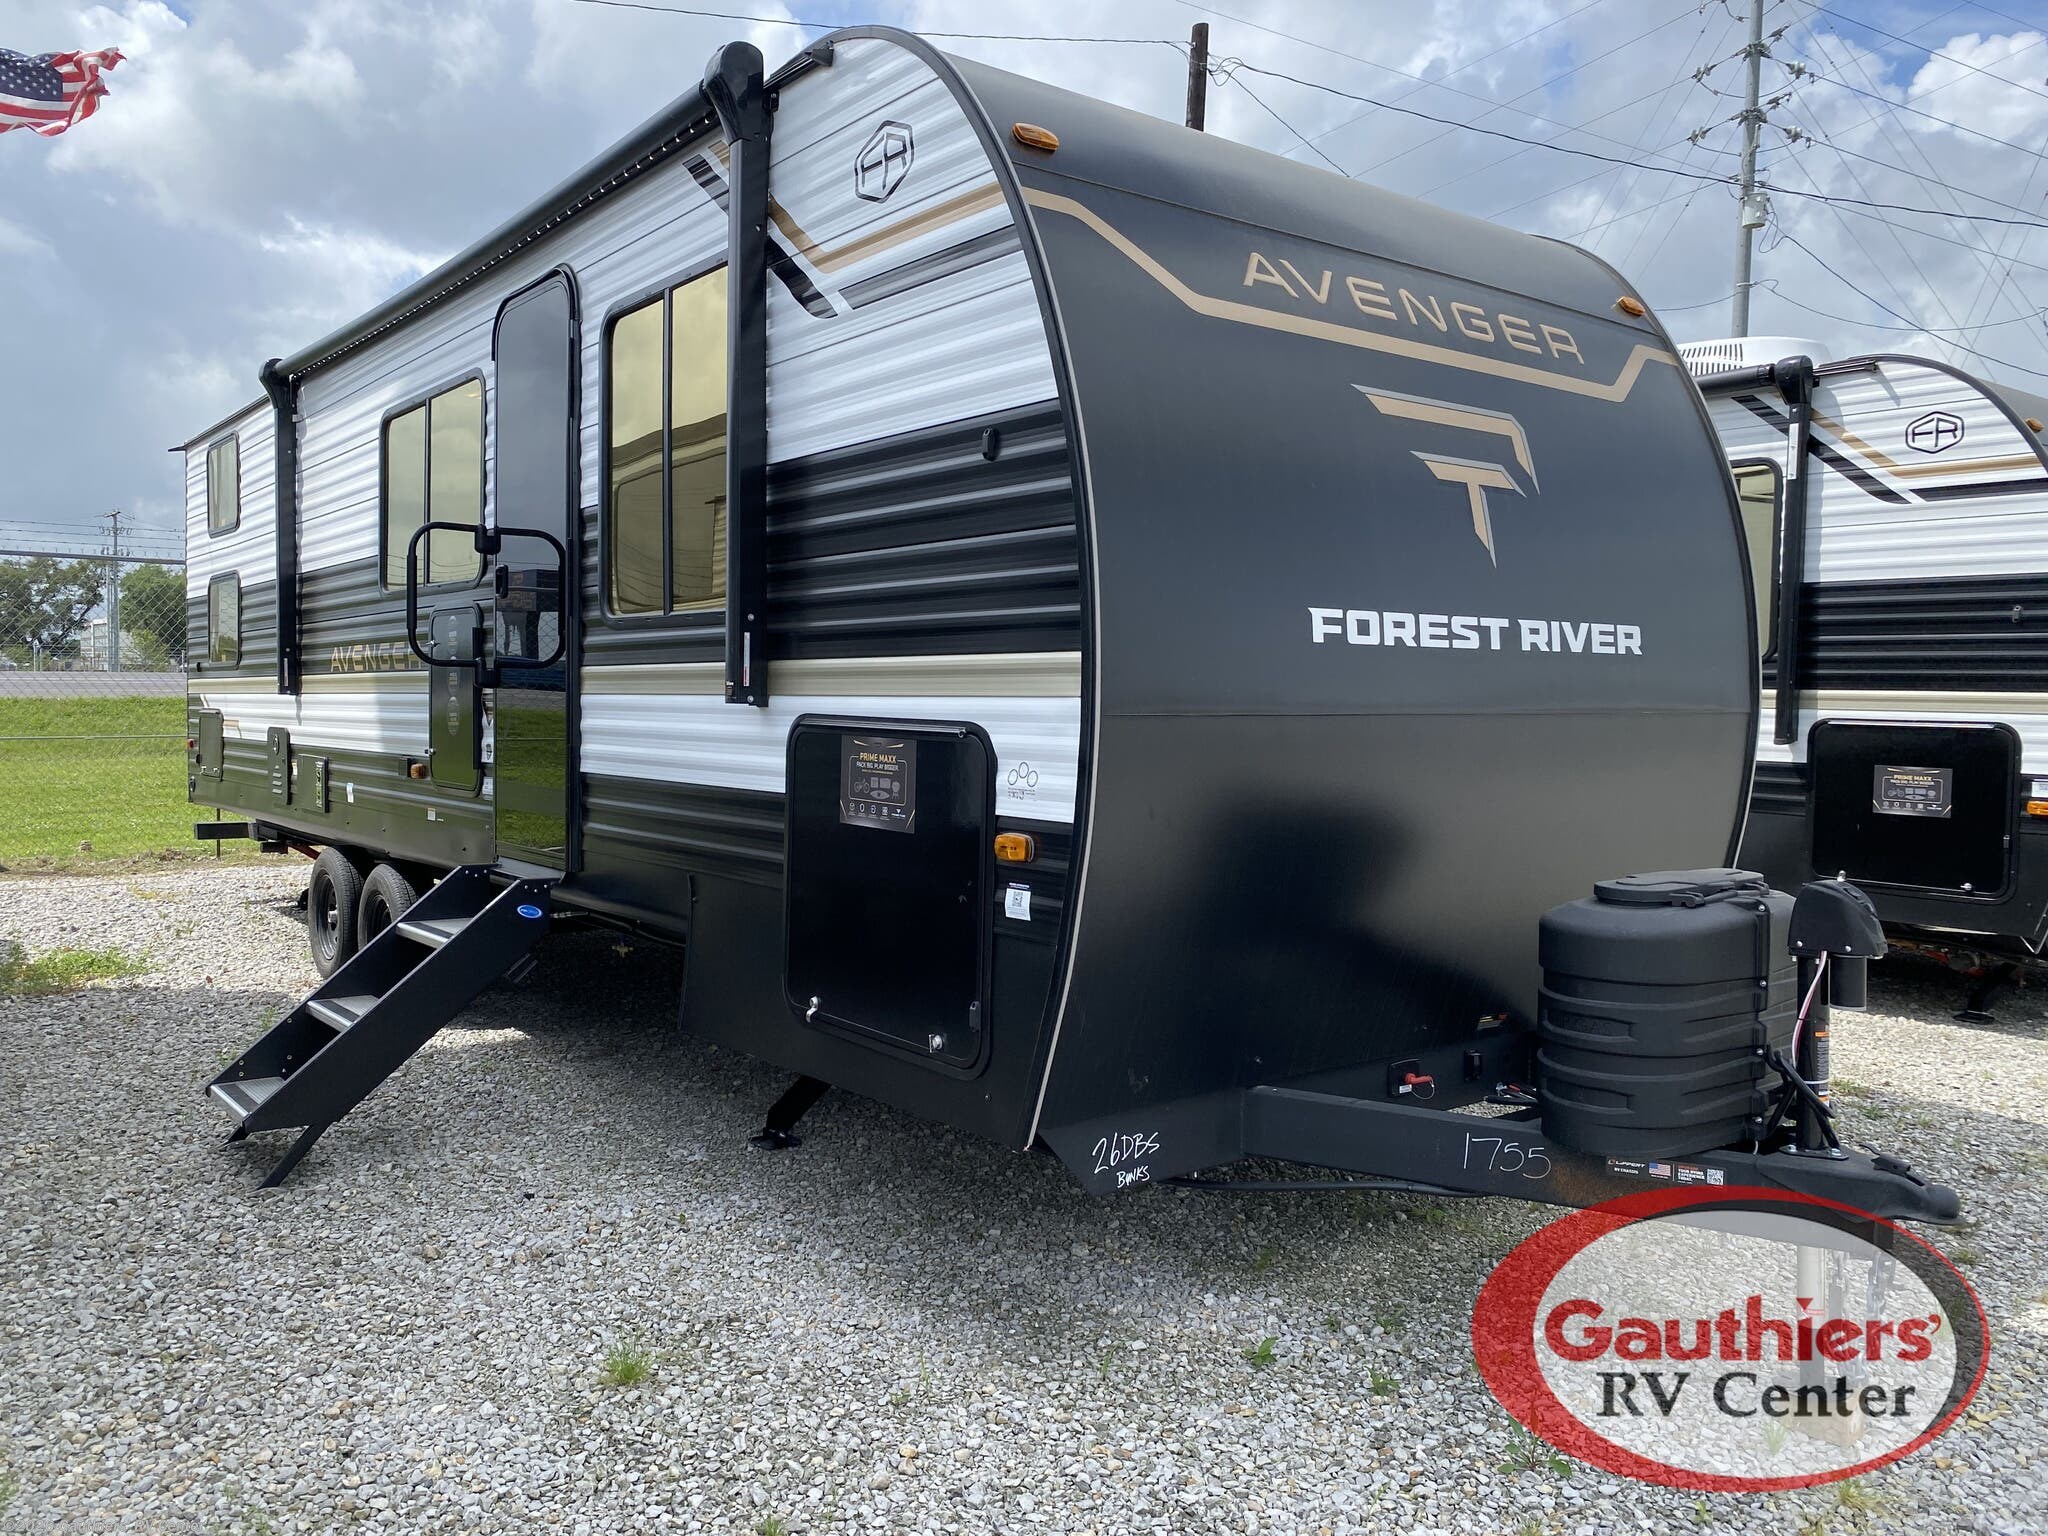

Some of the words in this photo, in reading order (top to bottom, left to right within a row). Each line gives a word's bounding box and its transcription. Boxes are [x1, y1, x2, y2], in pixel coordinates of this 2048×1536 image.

[1243, 252, 1585, 365] AVENGER
[1307, 606, 1511, 651] FOREST
[1517, 618, 1643, 656] RIVER
[860, 753, 878, 762] PRIME
[879, 755, 896, 763] MAXX
[1091, 1132, 1160, 1174] 26DBS
[1463, 1132, 1552, 1180] 1755
